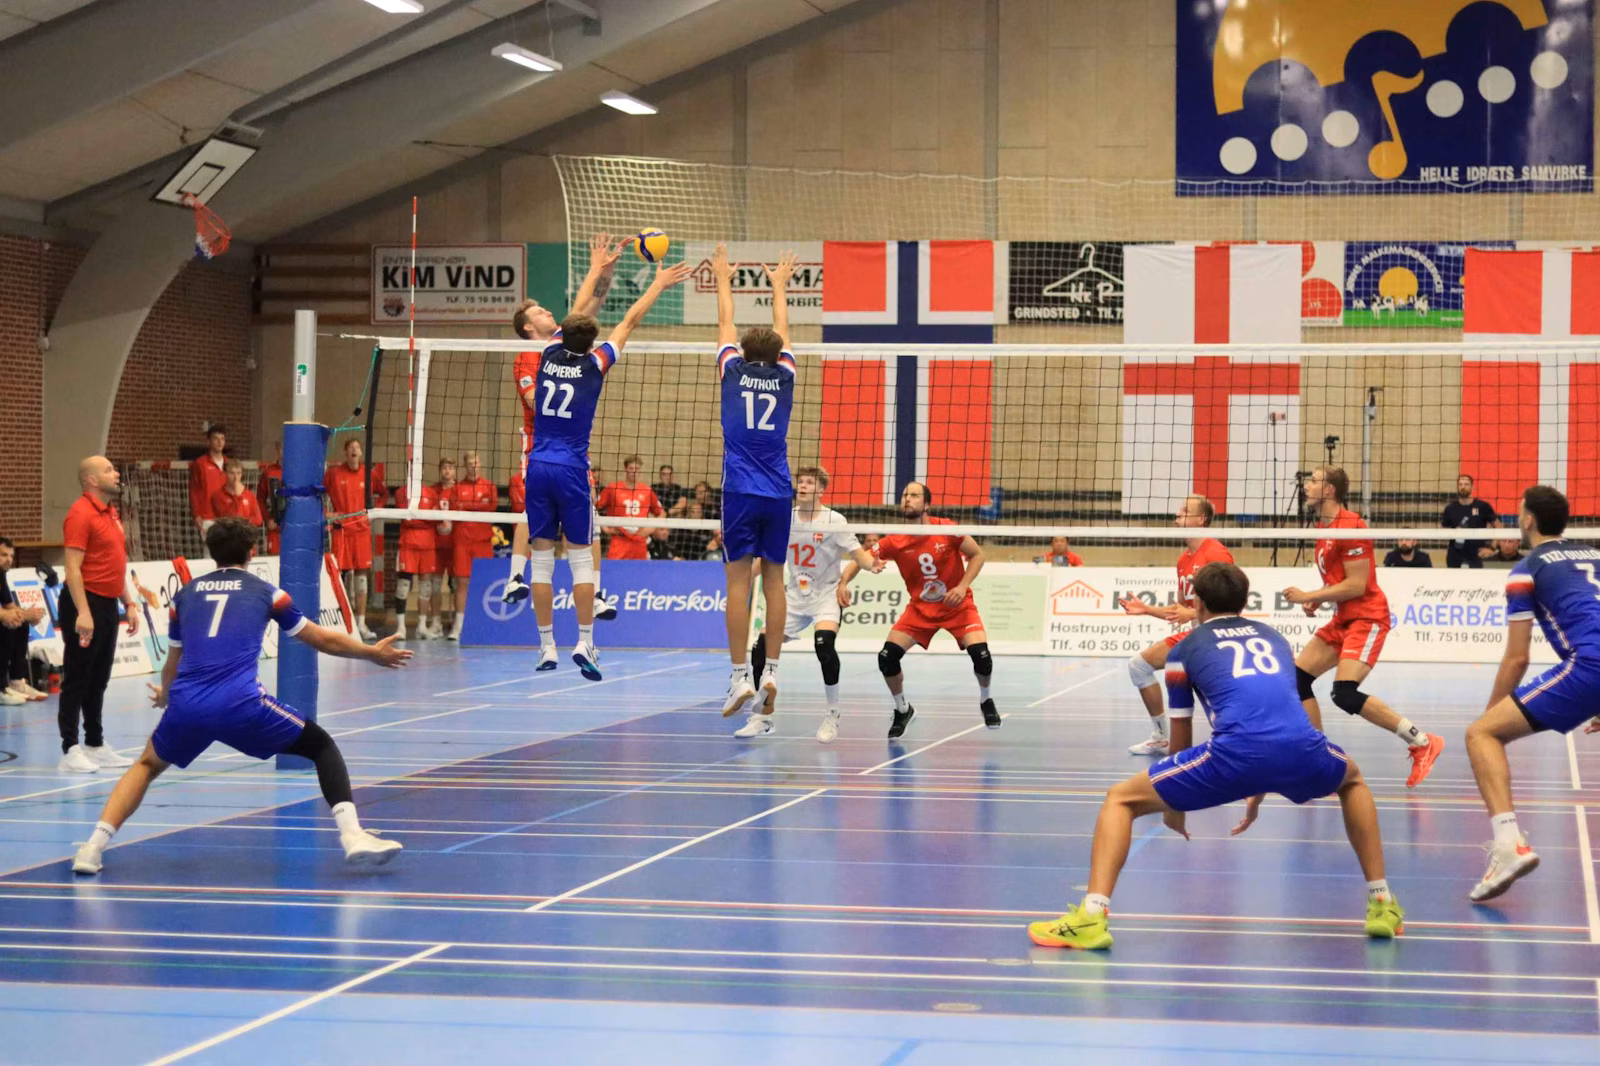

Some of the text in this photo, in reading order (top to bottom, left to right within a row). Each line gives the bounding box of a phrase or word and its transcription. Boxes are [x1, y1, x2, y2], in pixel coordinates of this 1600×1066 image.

[1420, 165, 1587, 182] HELLE IDRÆTS SAMVIRKE
[1014, 307, 1080, 319] GRINDSTED
[543, 360, 583, 378] LAPIERRE
[739, 374, 781, 391] DUTHOIT
[541, 380, 575, 419] 22
[741, 391, 777, 431] 12
[788, 543, 816, 568] 12
[918, 553, 937, 575] 8
[195, 580, 243, 592] ROURE
[1114, 577, 1178, 586] Tømrerfirm
[624, 589, 728, 612] Efterskole
[848, 585, 902, 607] jerg
[1413, 585, 1455, 601] Energi
[205, 594, 230, 638] 7
[1050, 622, 1131, 636] Hostrupvej
[1137, 623, 1151, 634] 11
[1212, 625, 1259, 638] MARE
[1271, 624, 1302, 635] 800
[1414, 630, 1503, 643] Tlf. 7519 6200
[1049, 639, 1073, 650] Tlf.
[1078, 639, 1096, 651] 40
[1100, 639, 1118, 651] 35
[1122, 639, 1141, 651] 06
[1216, 637, 1280, 679] 28
